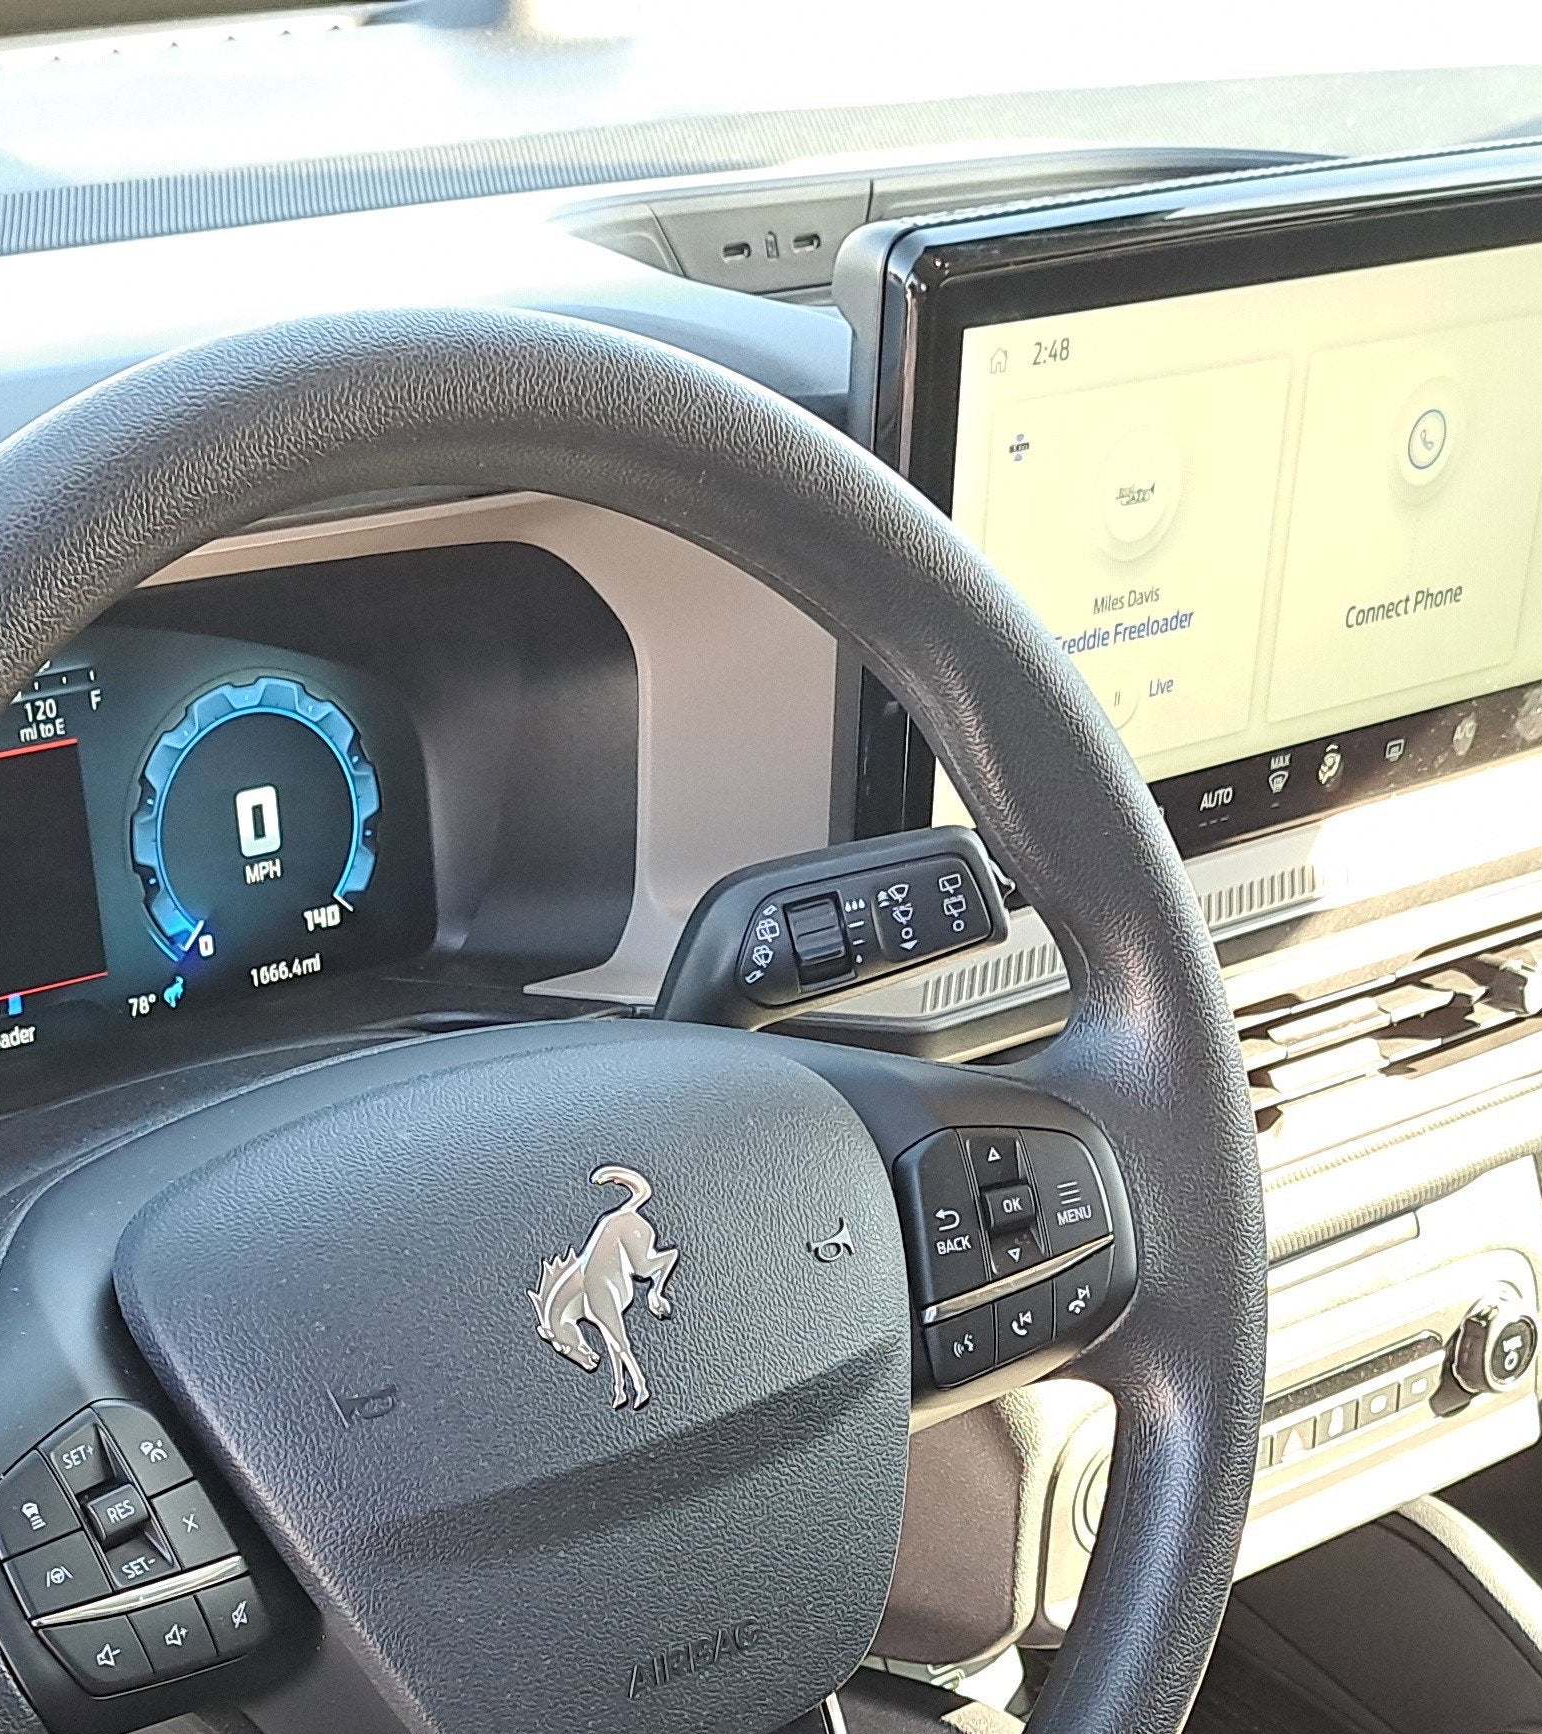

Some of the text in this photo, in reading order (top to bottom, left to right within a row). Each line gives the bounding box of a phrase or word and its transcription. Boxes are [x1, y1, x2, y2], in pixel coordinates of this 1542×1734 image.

[1032, 337, 1070, 367] 2:48
[1093, 586, 1161, 614] Miles Davis
[1345, 582, 1464, 629] Connect Phone
[1055, 609, 1194, 654] reddie Freeloader
[1149, 677, 1174, 698] Live
[23, 698, 57, 723] 120
[19, 723, 38, 743] mi
[39, 723, 55, 738] to
[1269, 753, 1291, 770] MAX
[1199, 786, 1234, 811] AUTO
[244, 858, 282, 885] MPH
[303, 904, 341, 931] 140
[198, 934, 214, 957] 0
[127, 993, 157, 1019] 78°
[1002, 1198, 1023, 1214] OK
[1056, 1208, 1093, 1226] MENU
[936, 1235, 972, 1255] BACK
[106, 1499, 136, 1525] RES
[627, 1614, 762, 1700] AIRBAG
